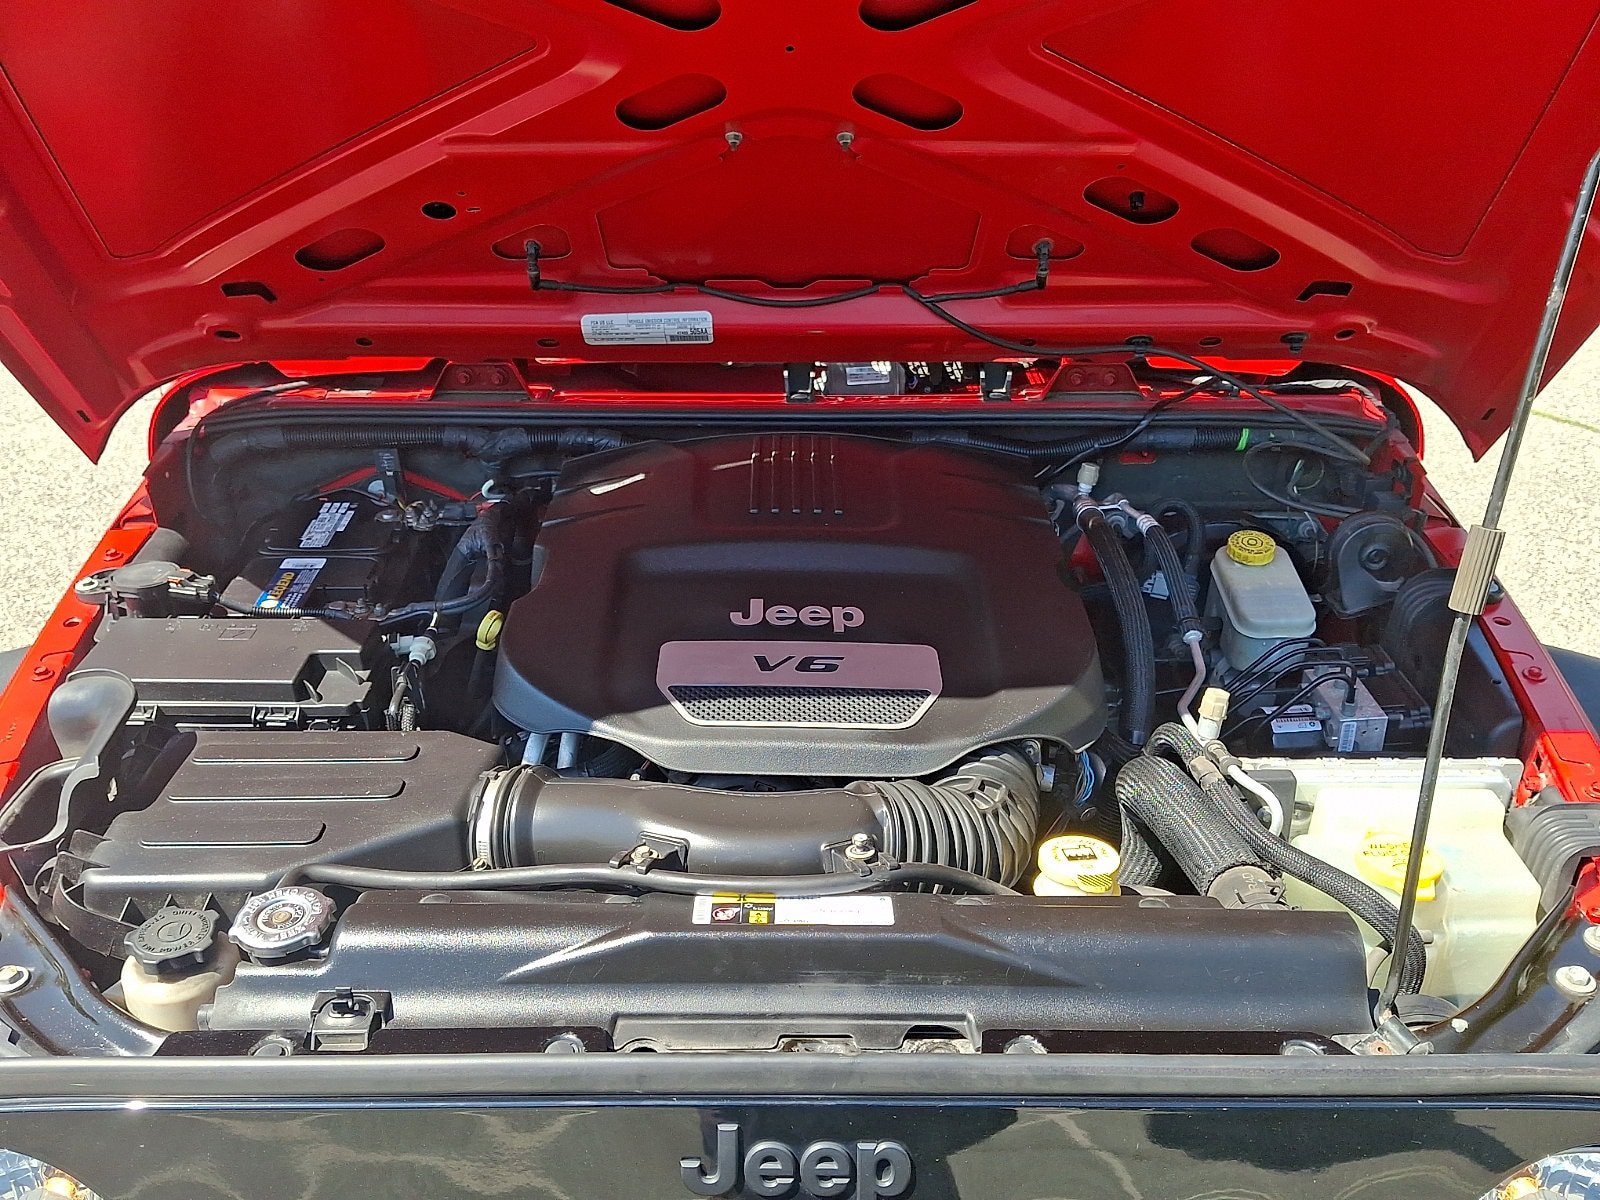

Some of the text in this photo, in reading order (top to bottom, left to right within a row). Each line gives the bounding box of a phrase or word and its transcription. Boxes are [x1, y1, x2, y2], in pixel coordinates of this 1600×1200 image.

[266, 572, 295, 600] LEGEND
[729, 598, 865, 633] Jeep
[753, 655, 845, 673] V6
[679, 1123, 913, 1200] Jeep
